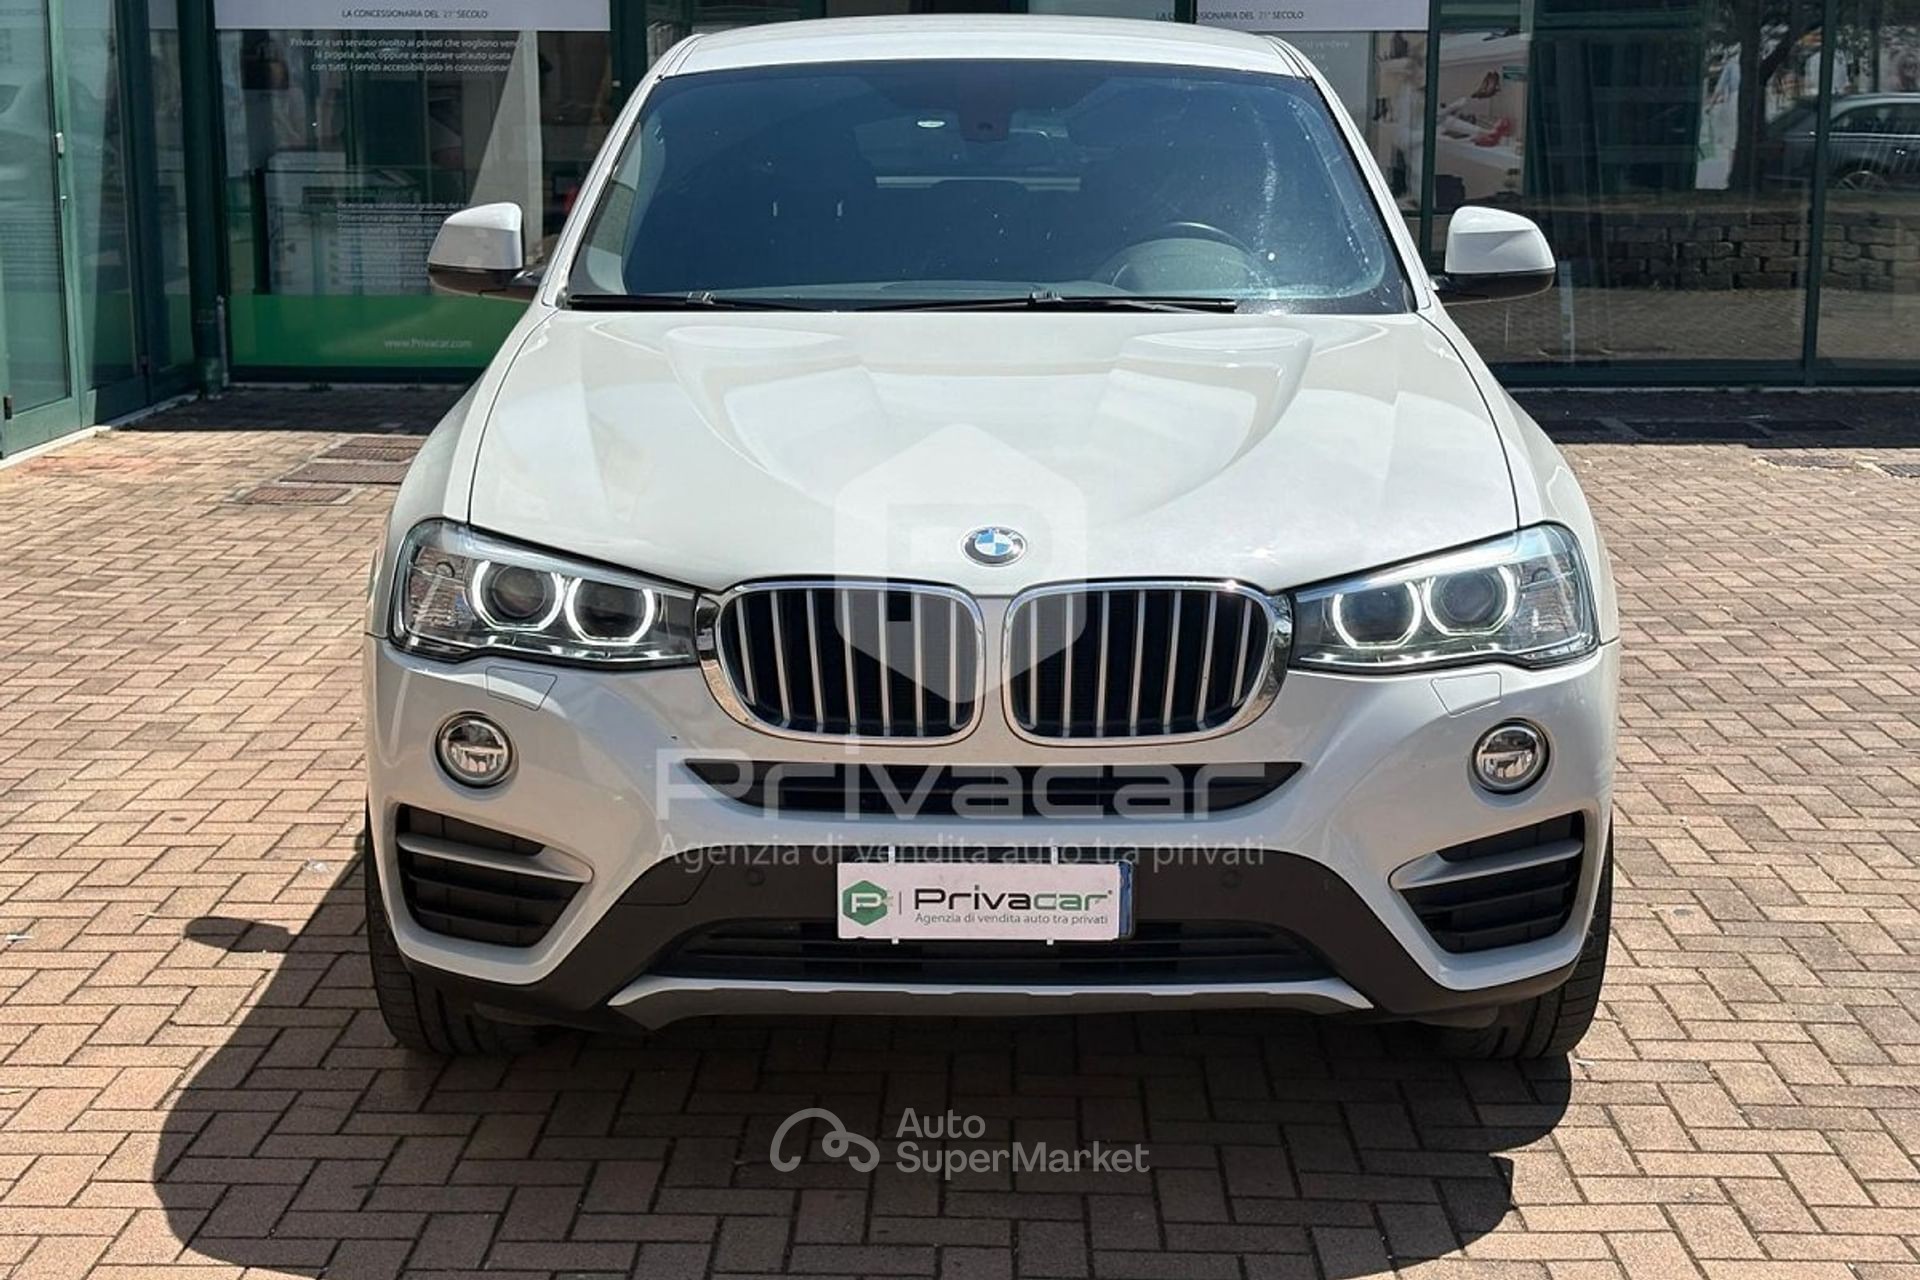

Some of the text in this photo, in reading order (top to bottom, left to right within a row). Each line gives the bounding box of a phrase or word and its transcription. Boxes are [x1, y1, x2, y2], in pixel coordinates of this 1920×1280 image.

[342, 10, 352, 18] LA
[353, 9, 423, 18] CONCESSIONARIA
[424, 9, 438, 18] DEL
[456, 9, 488, 18] SECOLO
[1239, 11, 1254, 20] DEL
[1273, 11, 1304, 19] SECOLO
[345, 39, 377, 47] servizio
[378, 39, 406, 47] rivolto
[416, 39, 443, 48] privati
[444, 39, 460, 47] che
[461, 39, 499, 50] vogliono
[378, 52, 409, 61] oppure
[384, 337, 472, 349] www.Privacar.com
[915, 913, 1108, 926] Agenzia di vendita auto tra privati
